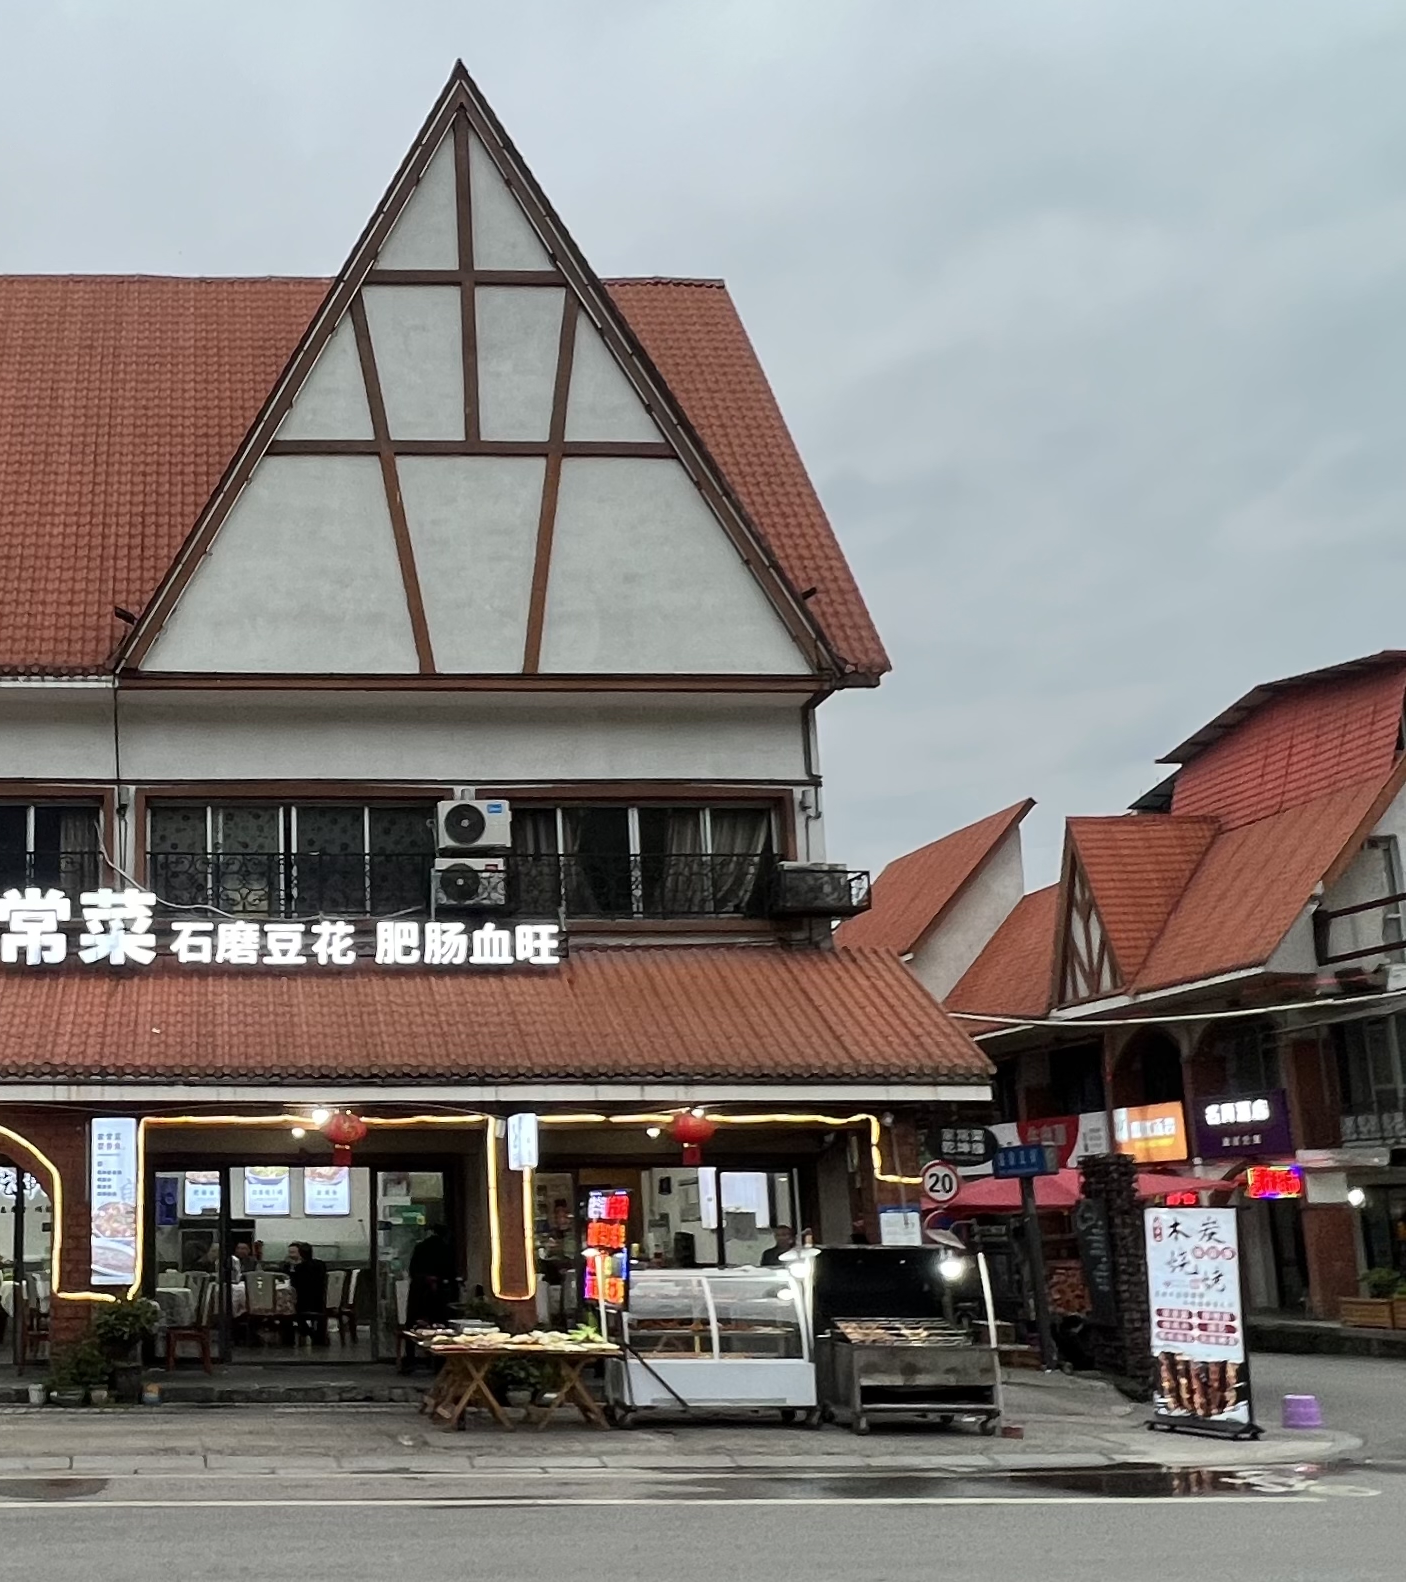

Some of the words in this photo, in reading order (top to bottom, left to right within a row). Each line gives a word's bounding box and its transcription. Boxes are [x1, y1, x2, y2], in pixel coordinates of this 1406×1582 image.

[169, 921, 358, 967] 石磨豆花
[374, 921, 561, 966] 肥肠血旺
[928, 1172, 954, 1194] 20
